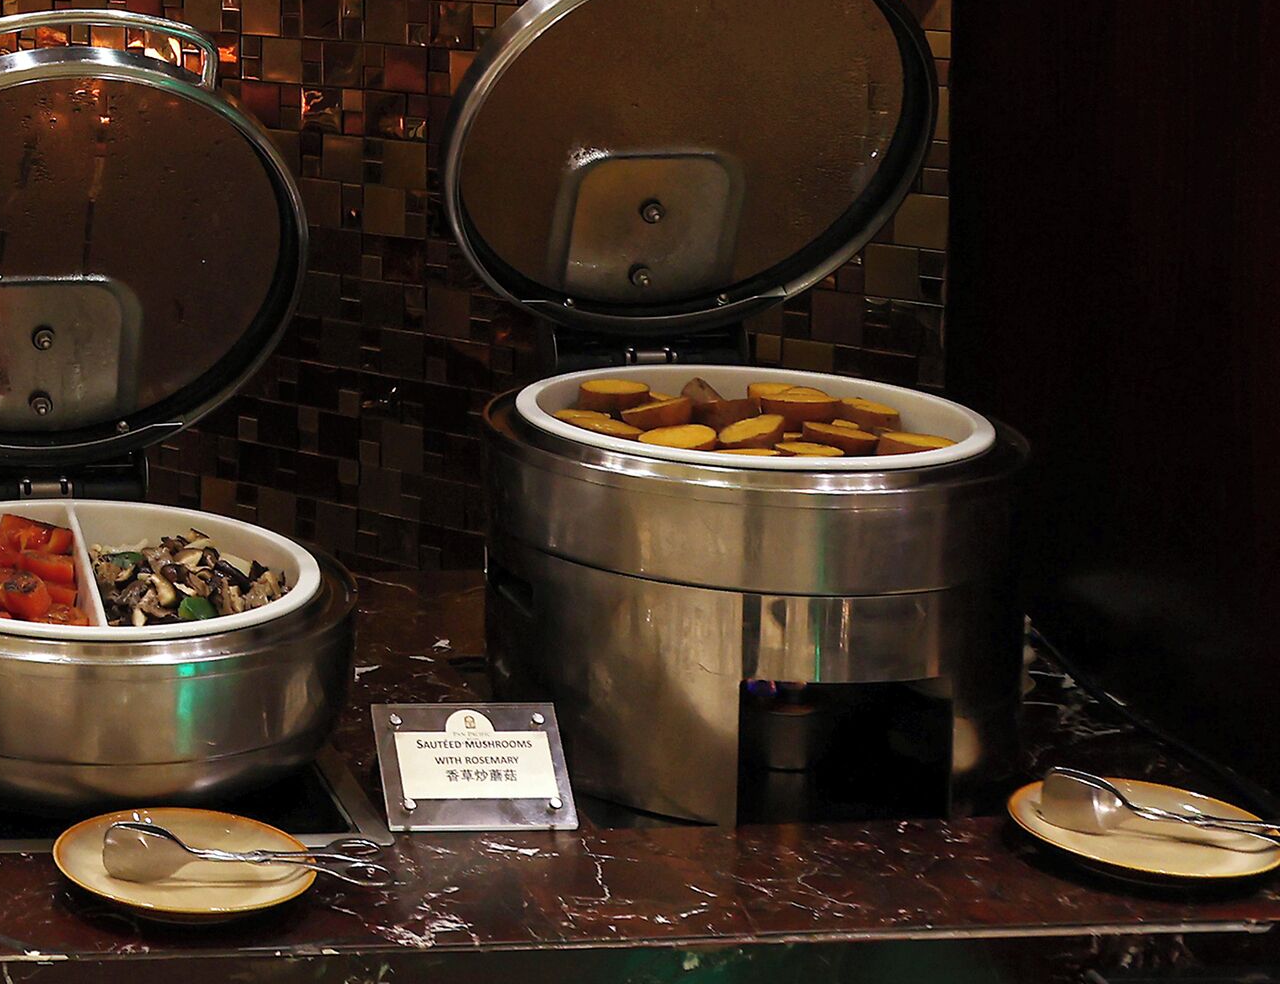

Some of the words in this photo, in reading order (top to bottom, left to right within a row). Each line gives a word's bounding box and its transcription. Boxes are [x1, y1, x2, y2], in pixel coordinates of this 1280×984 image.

[416, 738, 461, 749] SAUTÉED
[465, 739, 533, 749] MUSHROOMS
[434, 756, 463, 765] WITH
[465, 756, 520, 765] ROSEMARY
[446, 769, 518, 782] 香草炒蘑菇
